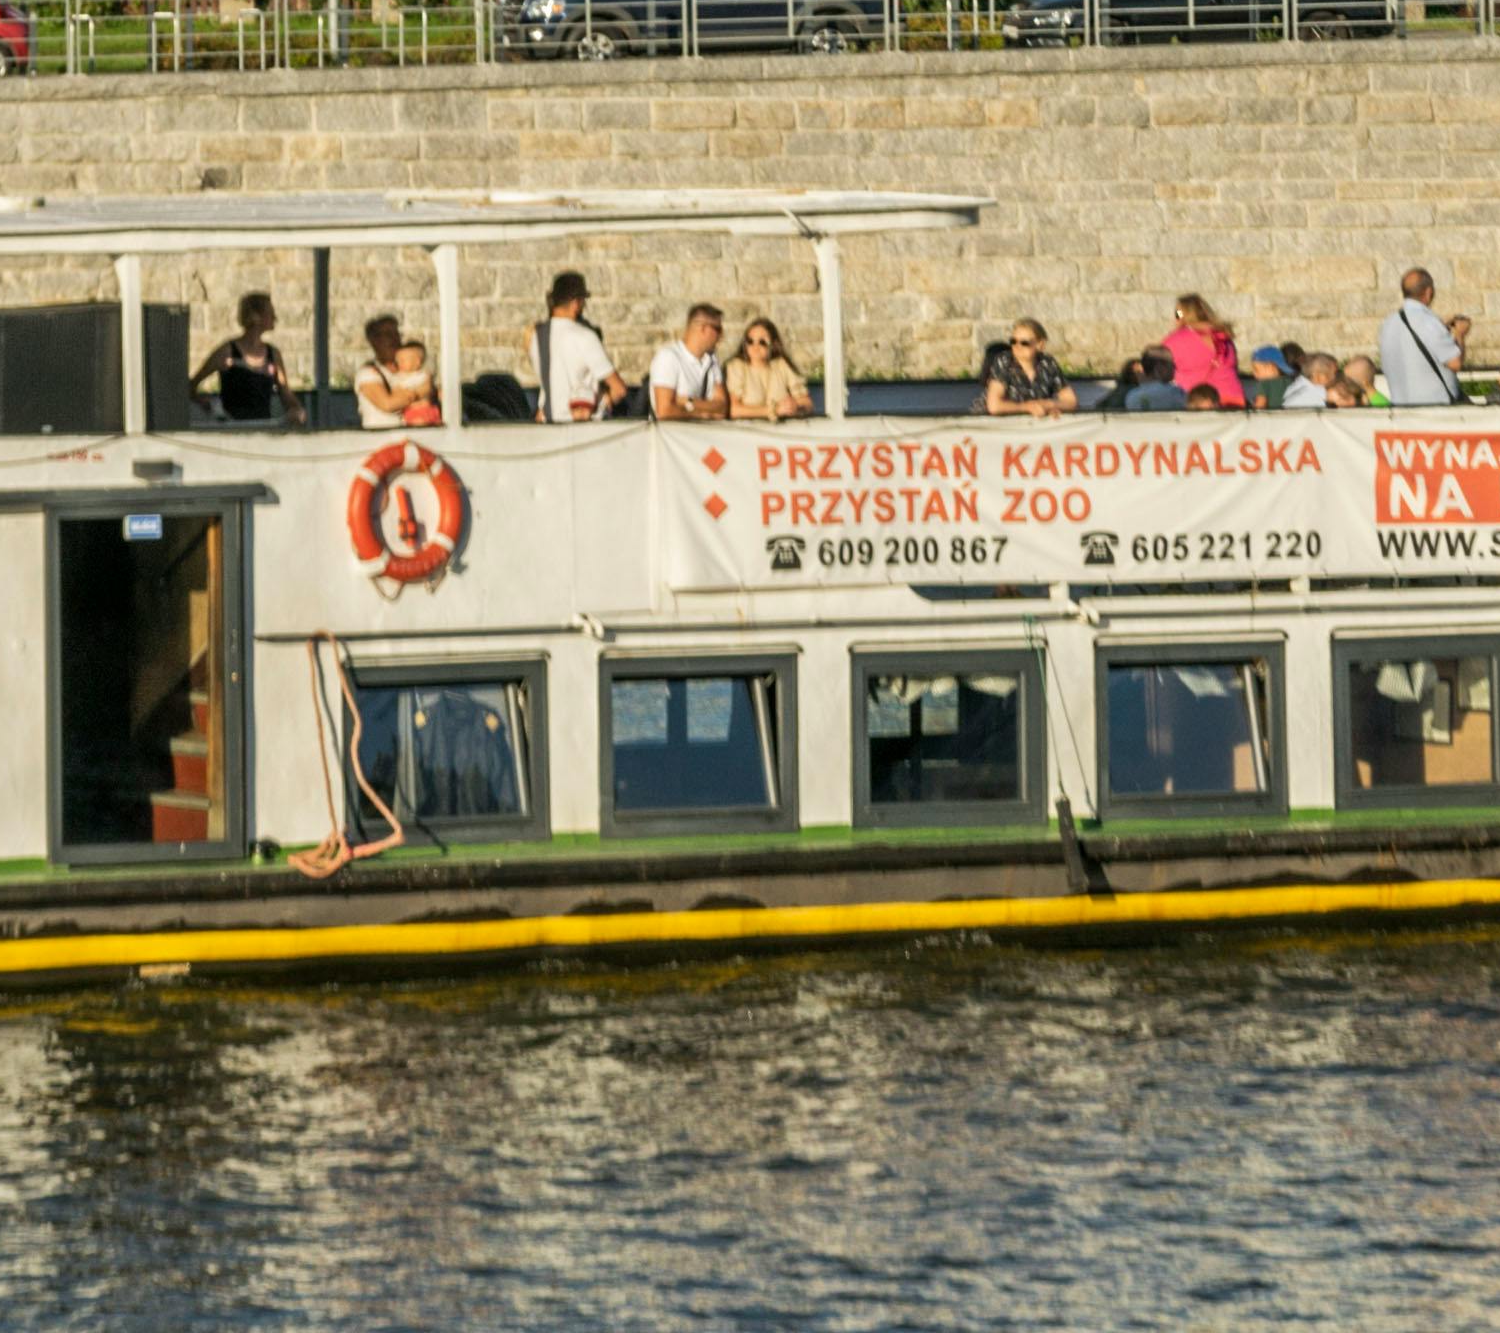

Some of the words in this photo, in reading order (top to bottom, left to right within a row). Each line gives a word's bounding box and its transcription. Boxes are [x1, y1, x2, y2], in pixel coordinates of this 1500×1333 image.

[756, 437, 980, 481] PRZYSTAŃ
[1002, 438, 1323, 479] KARDYNALSKA
[760, 481, 981, 527] PRZYSTAŃ
[1000, 487, 1093, 524] ZOO
[1388, 473, 1475, 520] NA
[816, 538, 875, 568] 609
[884, 536, 940, 566] 200
[949, 535, 1010, 565] 867
[1131, 533, 1190, 564] 605
[1198, 532, 1253, 561] 221
[1265, 530, 1323, 560] 220
